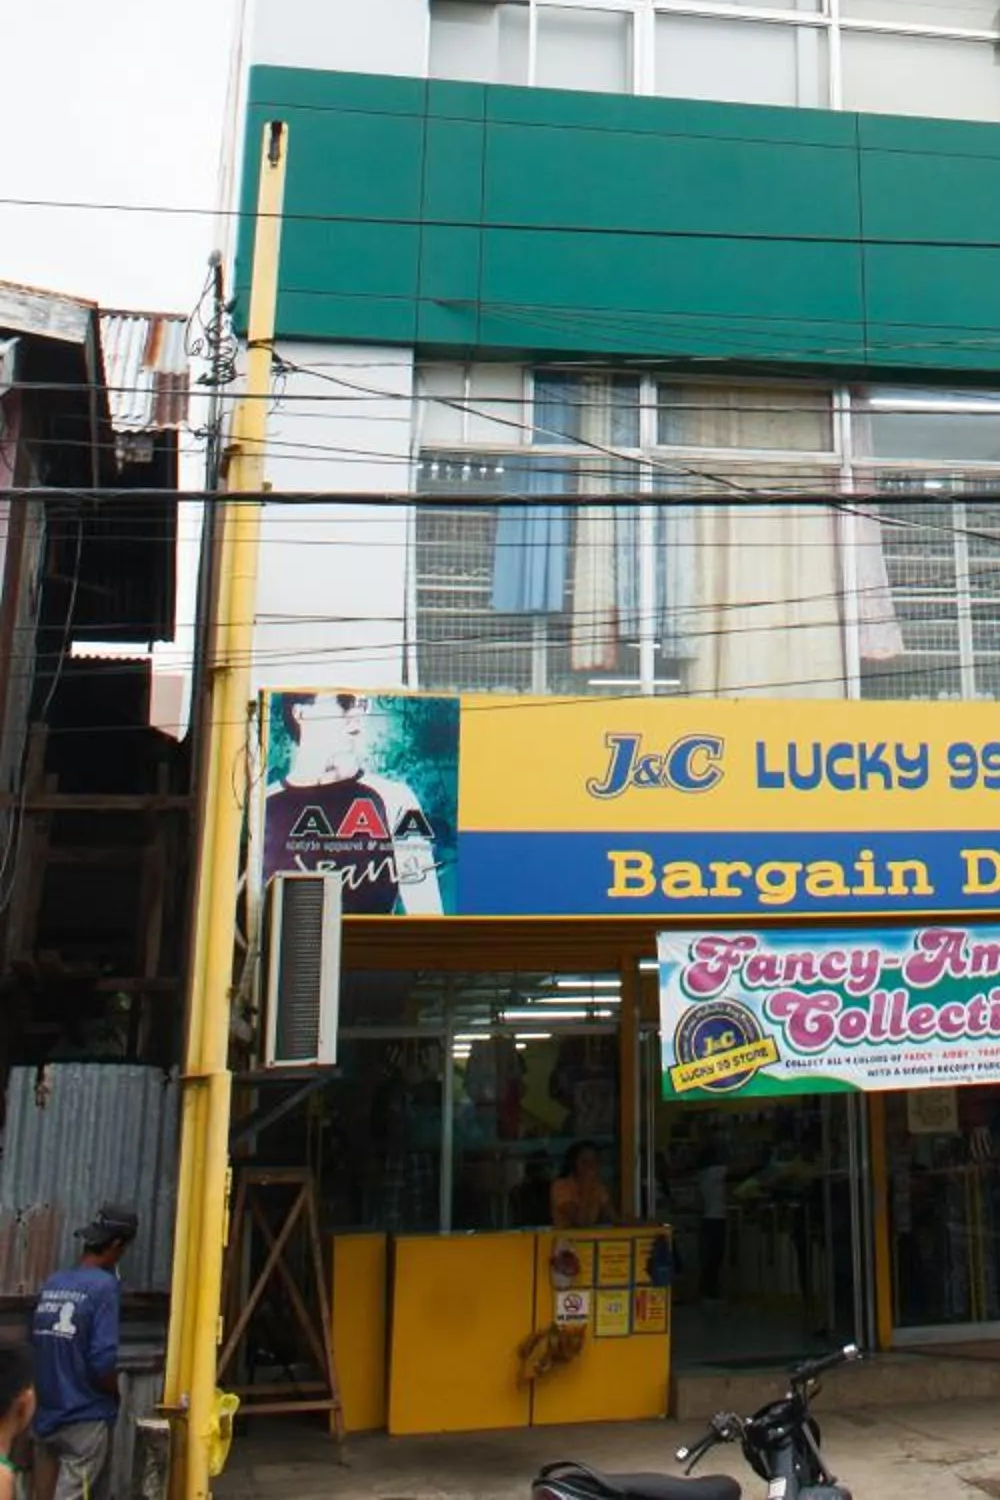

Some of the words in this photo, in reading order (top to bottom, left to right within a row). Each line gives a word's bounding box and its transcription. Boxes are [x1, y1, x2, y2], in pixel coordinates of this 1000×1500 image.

[586, 733, 724, 800] J&C
[756, 740, 929, 790] LUCKY
[289, 798, 436, 839] AAA
[607, 850, 935, 905] Bargain
